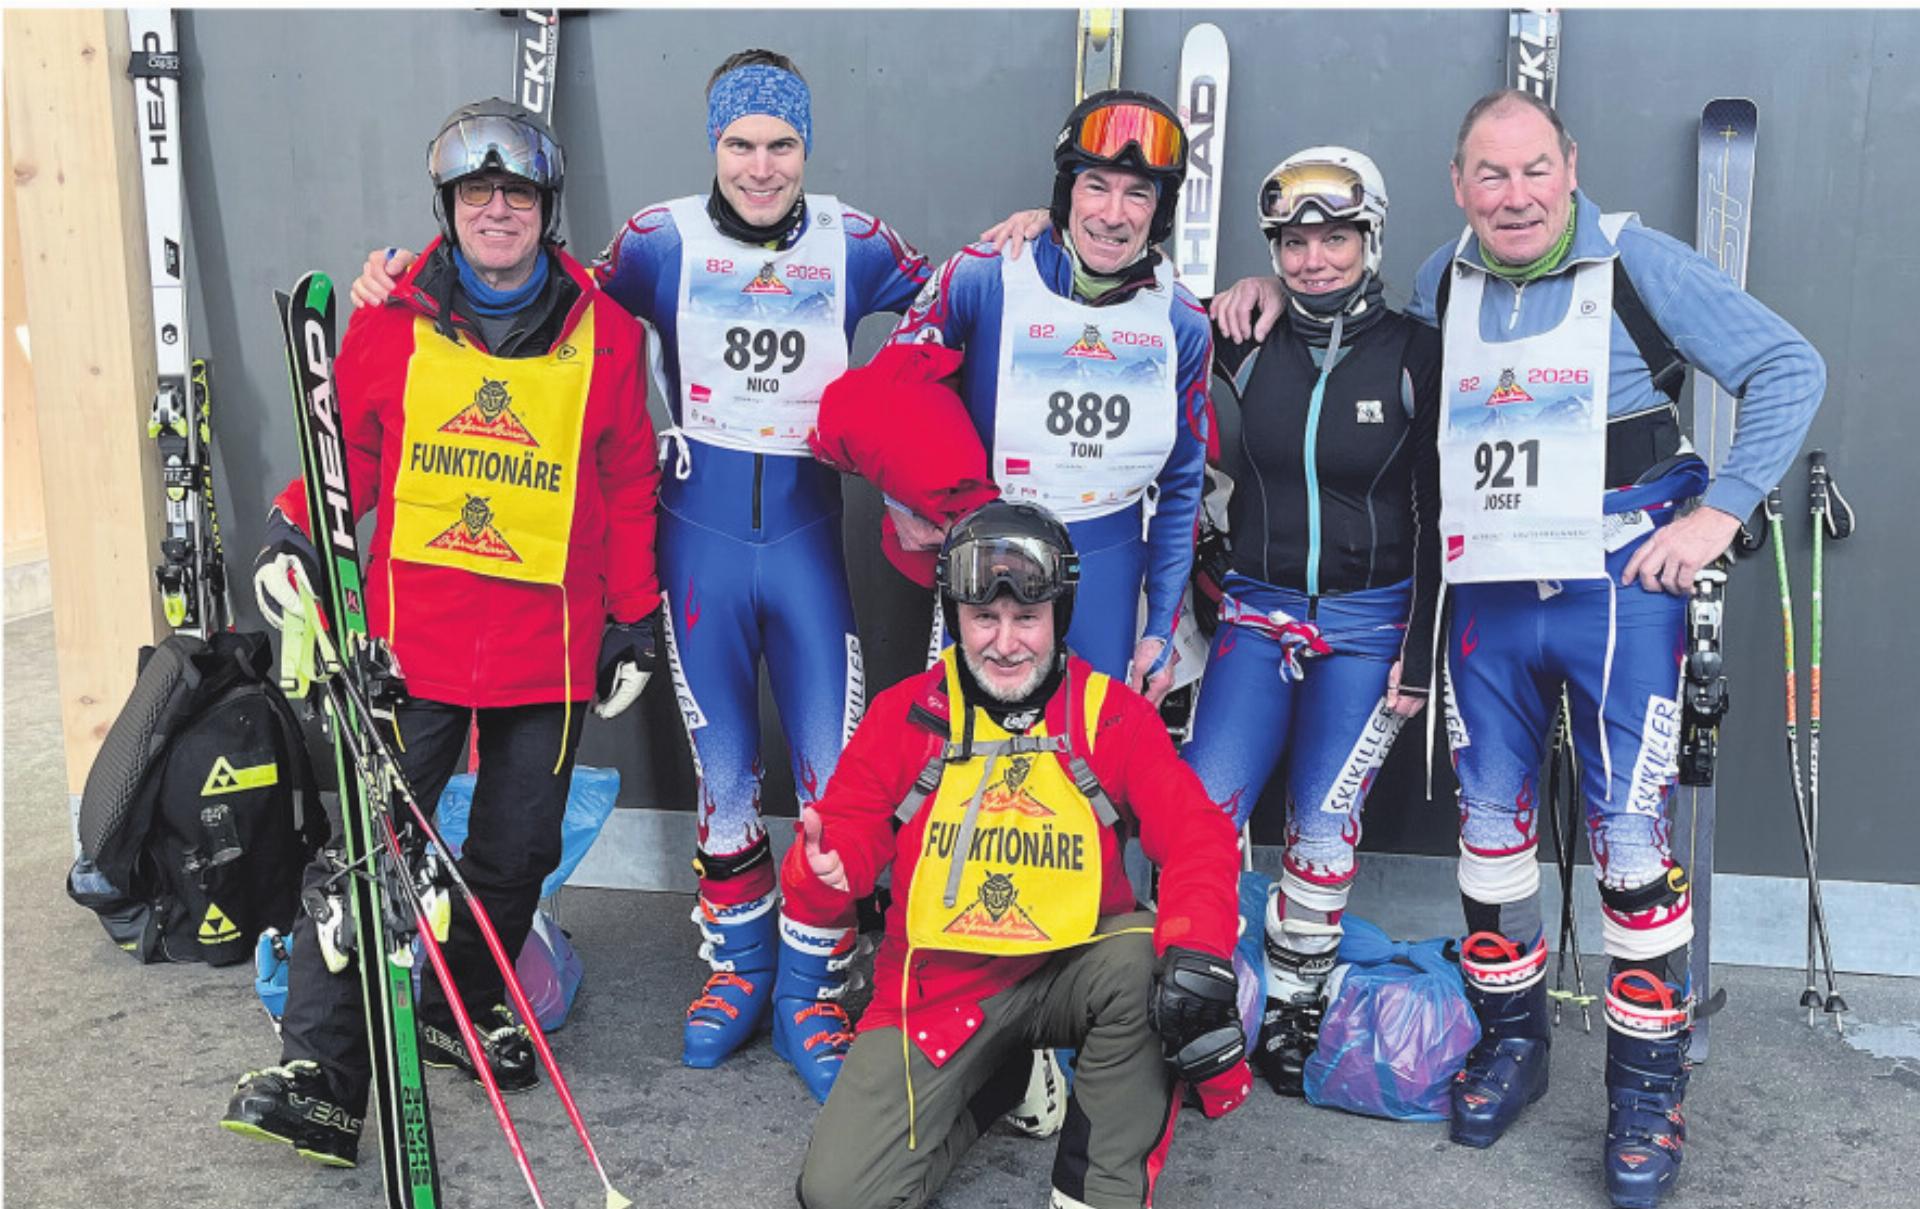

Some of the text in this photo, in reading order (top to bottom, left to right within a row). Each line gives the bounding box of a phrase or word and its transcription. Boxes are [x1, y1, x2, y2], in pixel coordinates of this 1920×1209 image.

[1183, 75, 1217, 275] HEAD
[786, 264, 831, 280] 2026
[724, 326, 805, 373] 899
[1112, 331, 1164, 348] 2026
[747, 377, 779, 393] NICO
[1528, 368, 1588, 384] 2026
[305, 319, 354, 550] HEAD
[1047, 390, 1130, 440] 889
[411, 443, 563, 492] FUNKTIONÄRE
[1070, 442, 1103, 459] TONI
[1474, 439, 1540, 490] 921
[1483, 494, 1521, 511] JOSEF
[1331, 704, 1393, 810] SKIKILLER
[1635, 703, 1676, 812] SKIKILLER
[1474, 964, 1536, 985] LANGE
